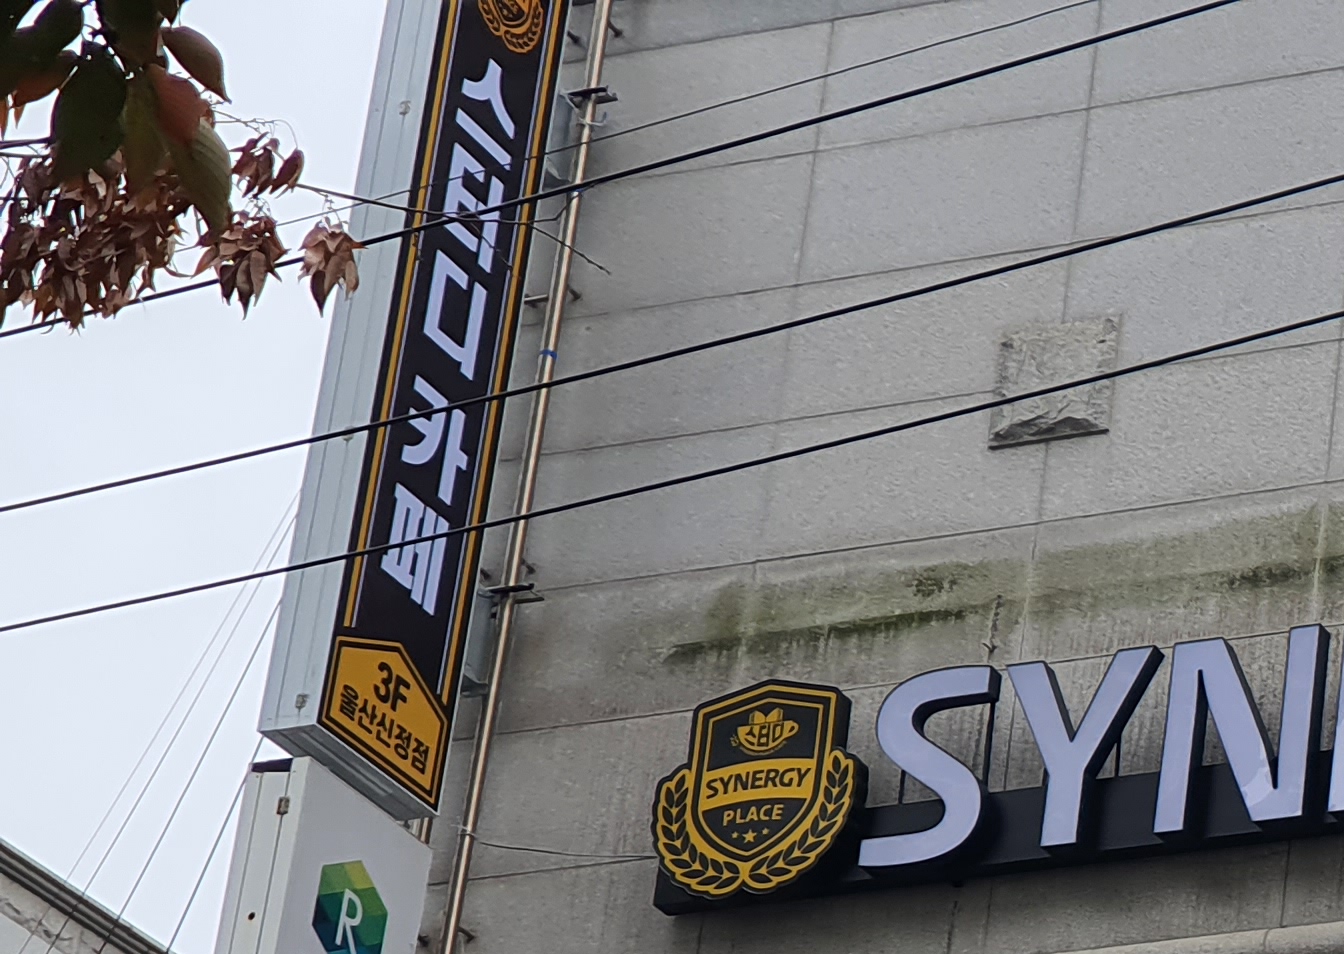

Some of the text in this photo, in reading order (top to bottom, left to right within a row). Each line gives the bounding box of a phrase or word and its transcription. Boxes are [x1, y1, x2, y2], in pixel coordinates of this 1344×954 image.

[380, 58, 516, 616] 스터디카페
[373, 661, 411, 712] 3F
[340, 684, 431, 775] 울산신정점
[706, 767, 811, 799] SYNERGY
[723, 804, 784, 826] PLACE
